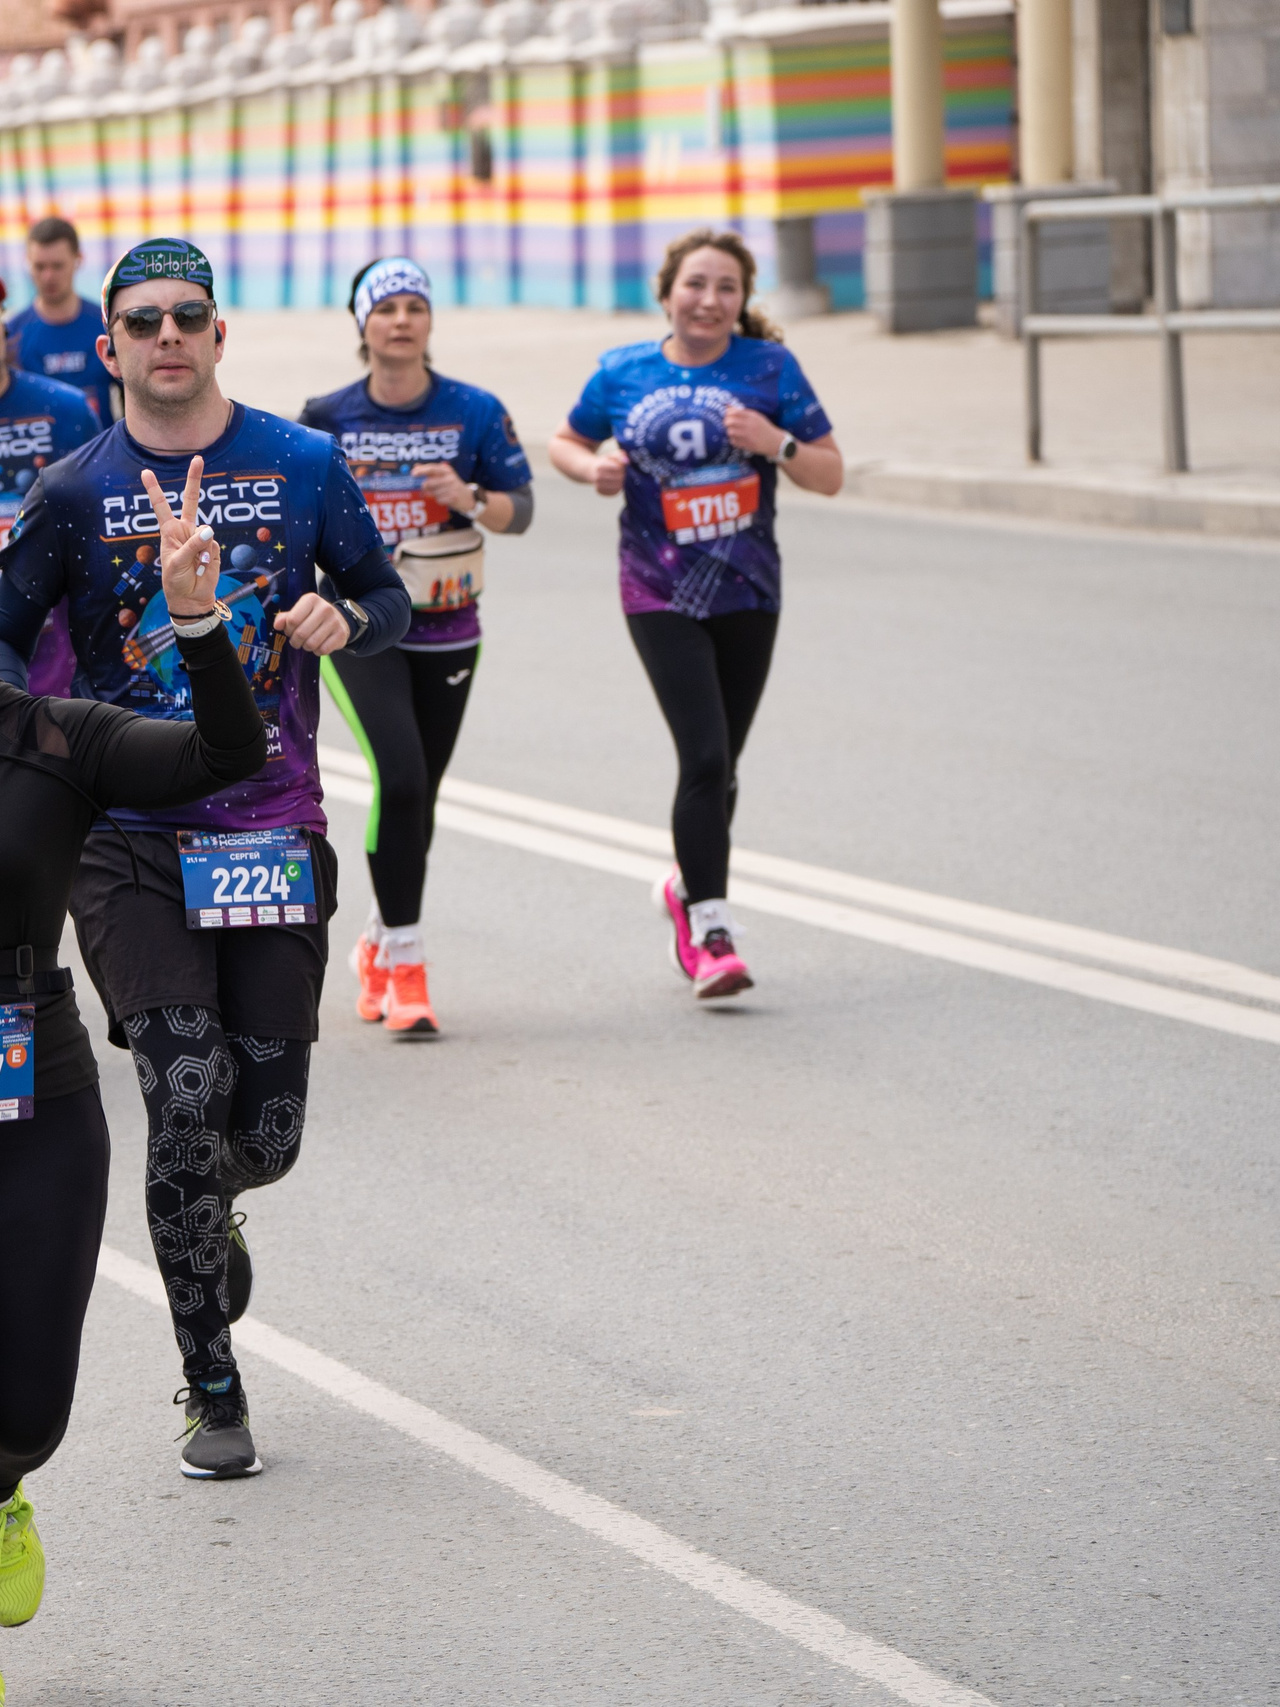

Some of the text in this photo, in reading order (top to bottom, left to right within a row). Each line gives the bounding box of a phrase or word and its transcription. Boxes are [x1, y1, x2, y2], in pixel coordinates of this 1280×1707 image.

[360, 429, 461, 447] ПРОСТО
[669, 418, 708, 462] Я
[103, 496, 126, 514] Я
[371, 501, 428, 531] 1365
[689, 491, 740, 526] 1716
[104, 501, 282, 537] КОМОС
[219, 837, 273, 847] КОСМОС
[228, 830, 272, 839] ПРОСТО
[229, 851, 261, 861] СЕРГЕЙ
[211, 865, 291, 904] 2224
